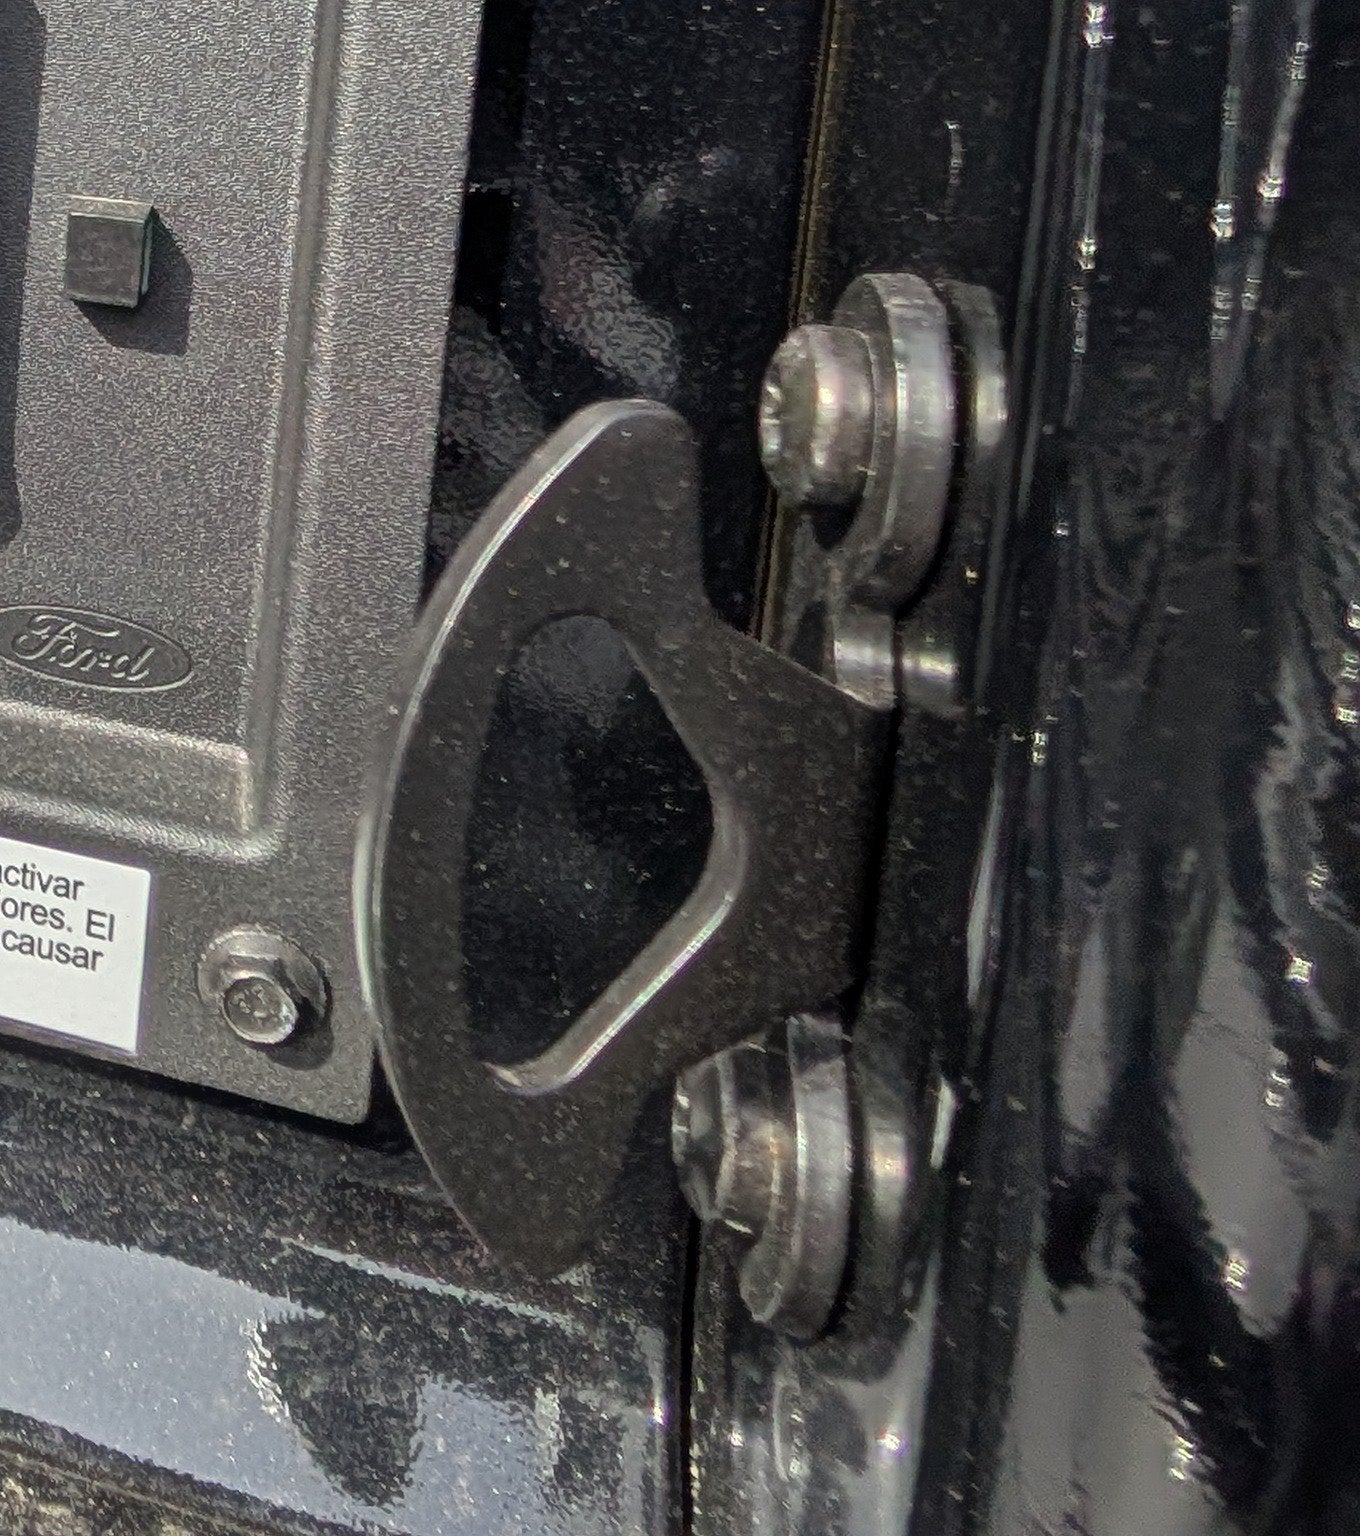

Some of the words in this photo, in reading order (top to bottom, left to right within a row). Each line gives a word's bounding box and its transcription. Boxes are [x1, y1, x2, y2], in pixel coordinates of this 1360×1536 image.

[11, 614, 155, 682] Ford
[85, 907, 116, 943] El
[0, 929, 105, 972] causar
